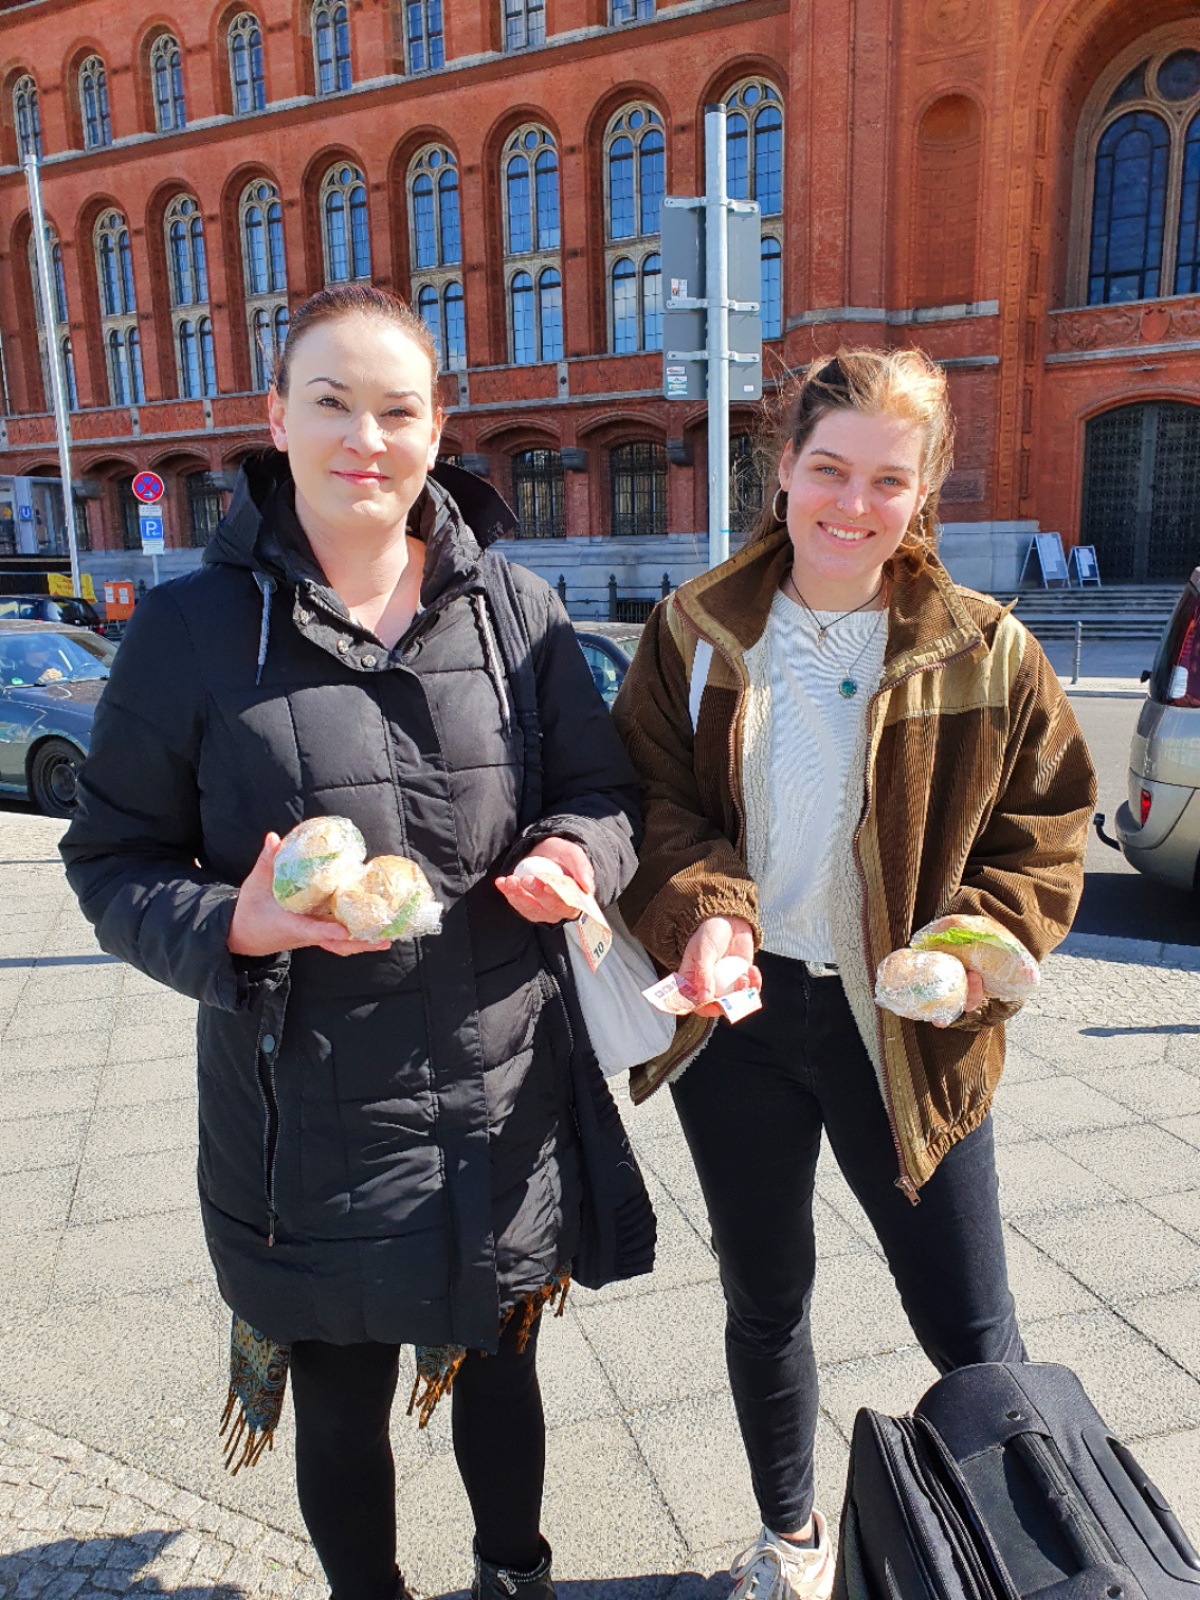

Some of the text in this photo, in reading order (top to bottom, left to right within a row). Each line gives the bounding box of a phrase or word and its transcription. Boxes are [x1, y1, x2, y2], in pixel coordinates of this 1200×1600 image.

[22, 507, 29, 518] U
[145, 521, 157, 536] P
[593, 941, 605, 958] 10
